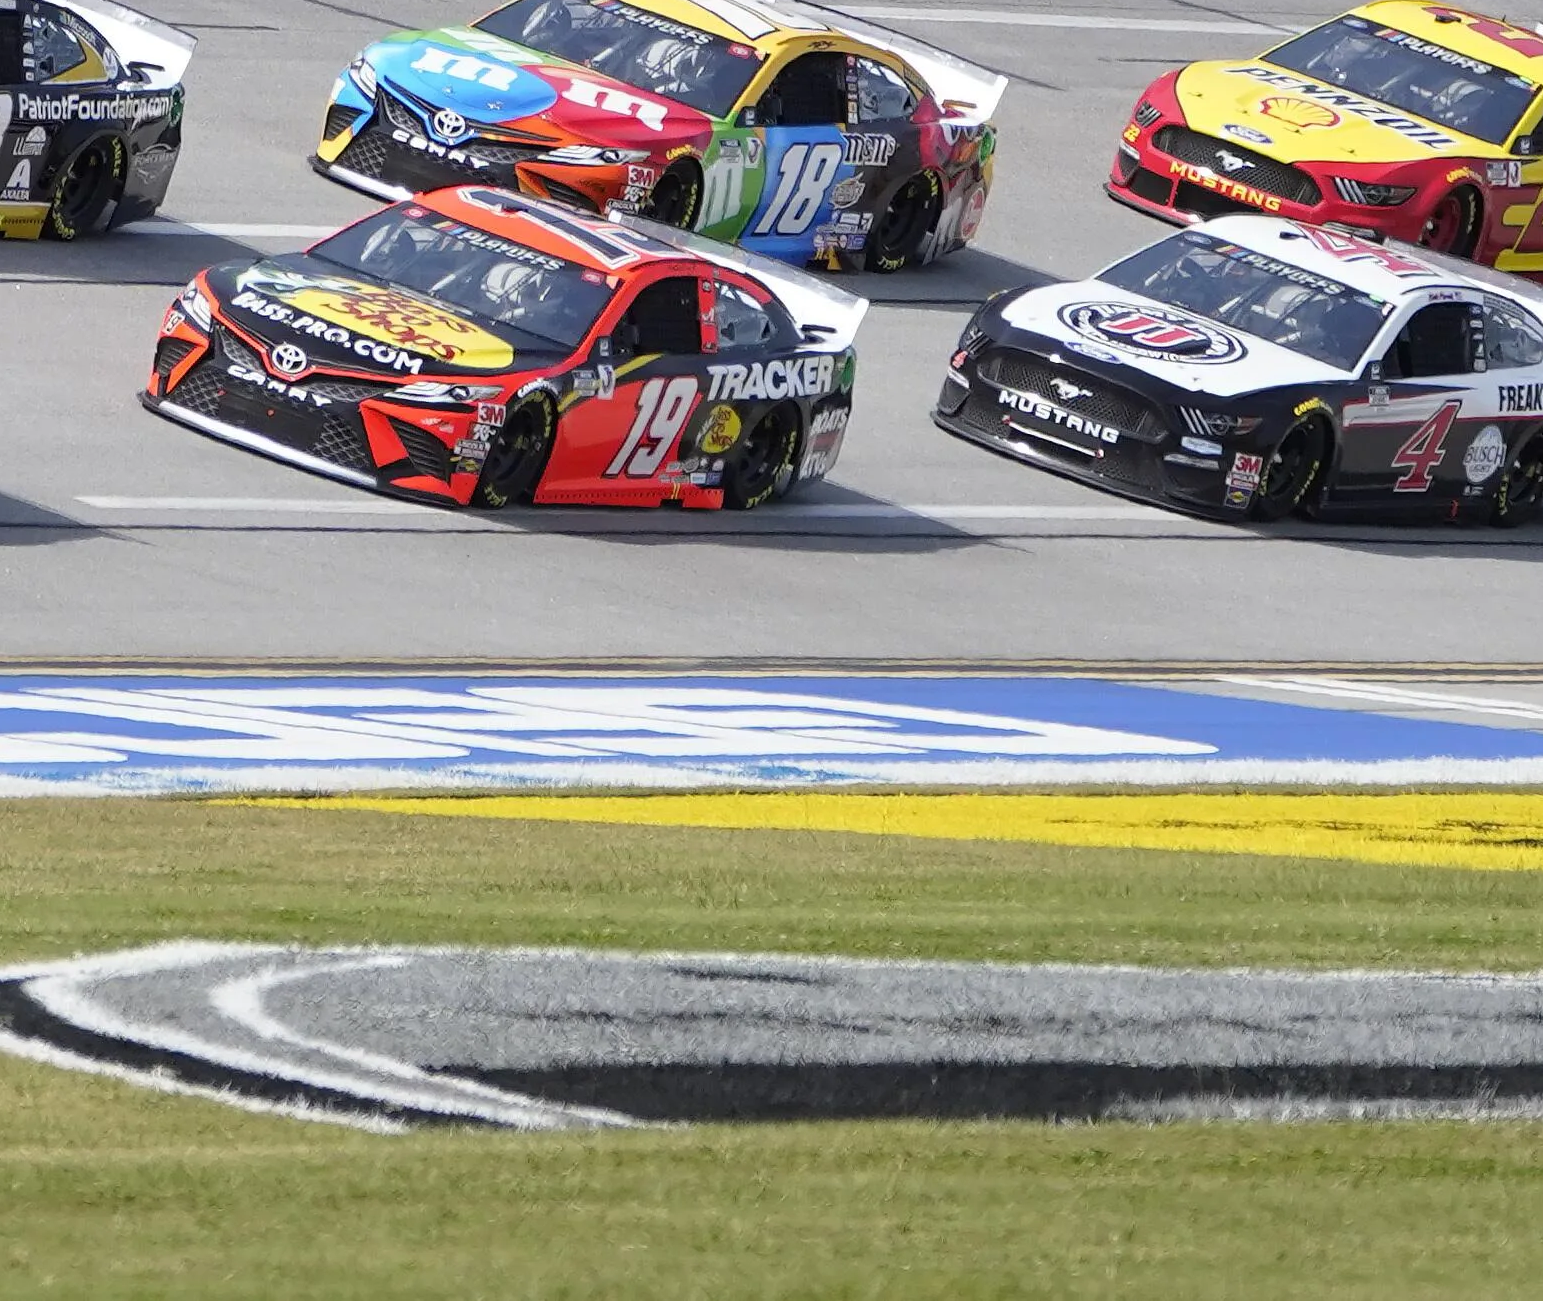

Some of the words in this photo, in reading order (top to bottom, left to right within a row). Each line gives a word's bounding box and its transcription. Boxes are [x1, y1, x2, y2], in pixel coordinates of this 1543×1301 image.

[1398, 36, 1493, 75] PLAYOFFS
[18, 92, 170, 123] PatriotFoundation.com
[1223, 67, 1457, 150] PENNZOIL
[391, 128, 490, 170] CAMRY
[629, 167, 654, 188] 3M
[752, 142, 844, 236] 18
[1169, 160, 1283, 213] MUSTANG
[459, 231, 566, 271] PLAYOFFS
[227, 364, 332, 407] CAMRY
[707, 354, 835, 401] TRACKER
[478, 404, 505, 426] 3M
[601, 375, 701, 479] 19
[998, 389, 1122, 445] MUSTANG
[1235, 454, 1262, 472] 3M
[1390, 398, 1463, 494] 4
[1464, 444, 1507, 465] BUSCH
